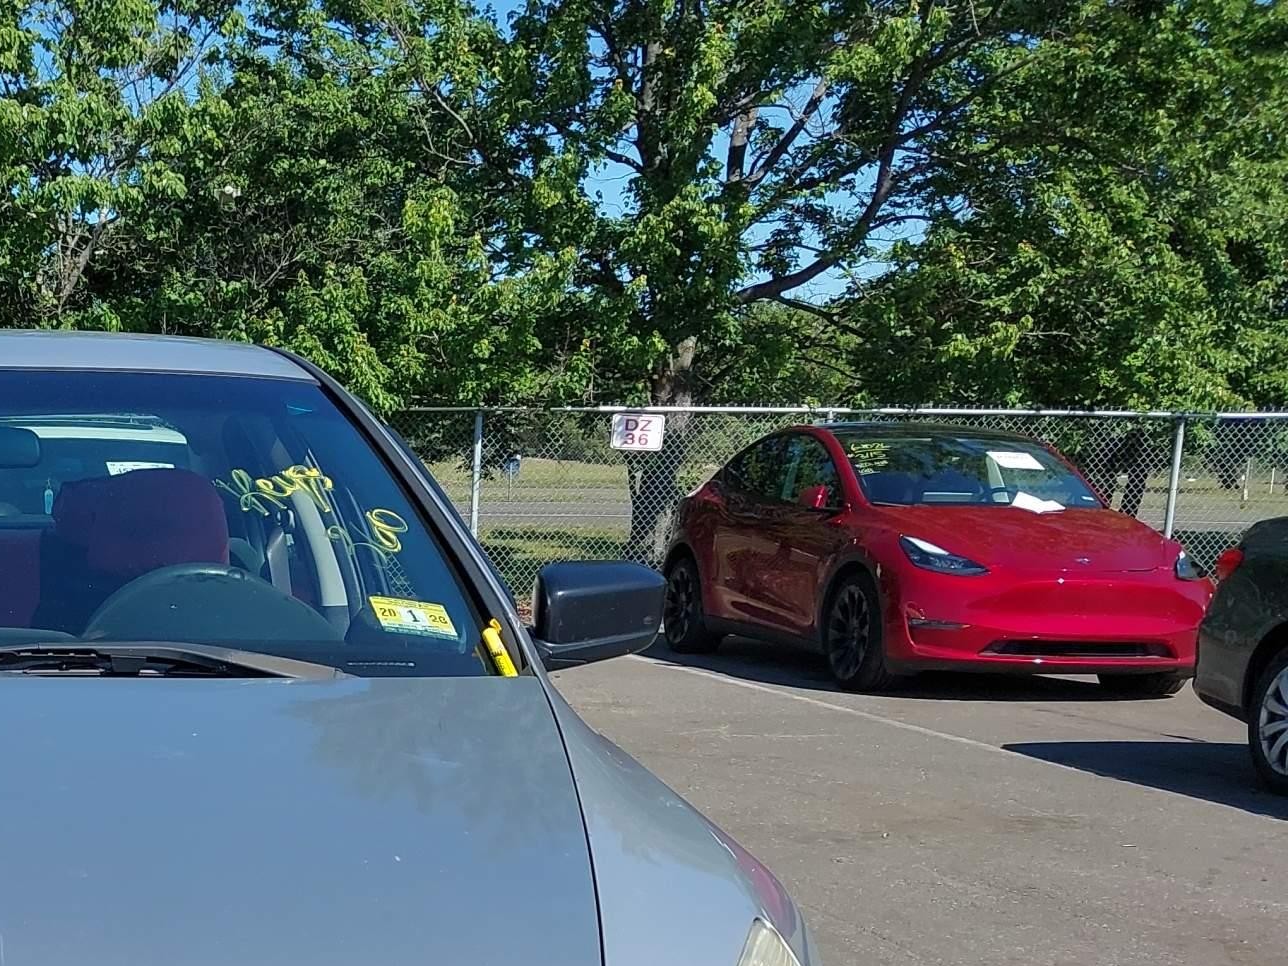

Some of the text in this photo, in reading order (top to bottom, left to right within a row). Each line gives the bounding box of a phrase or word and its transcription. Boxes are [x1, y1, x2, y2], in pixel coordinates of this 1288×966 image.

[624, 418, 653, 432] DZ
[622, 432, 649, 446] 36
[406, 609, 420, 623] 1
